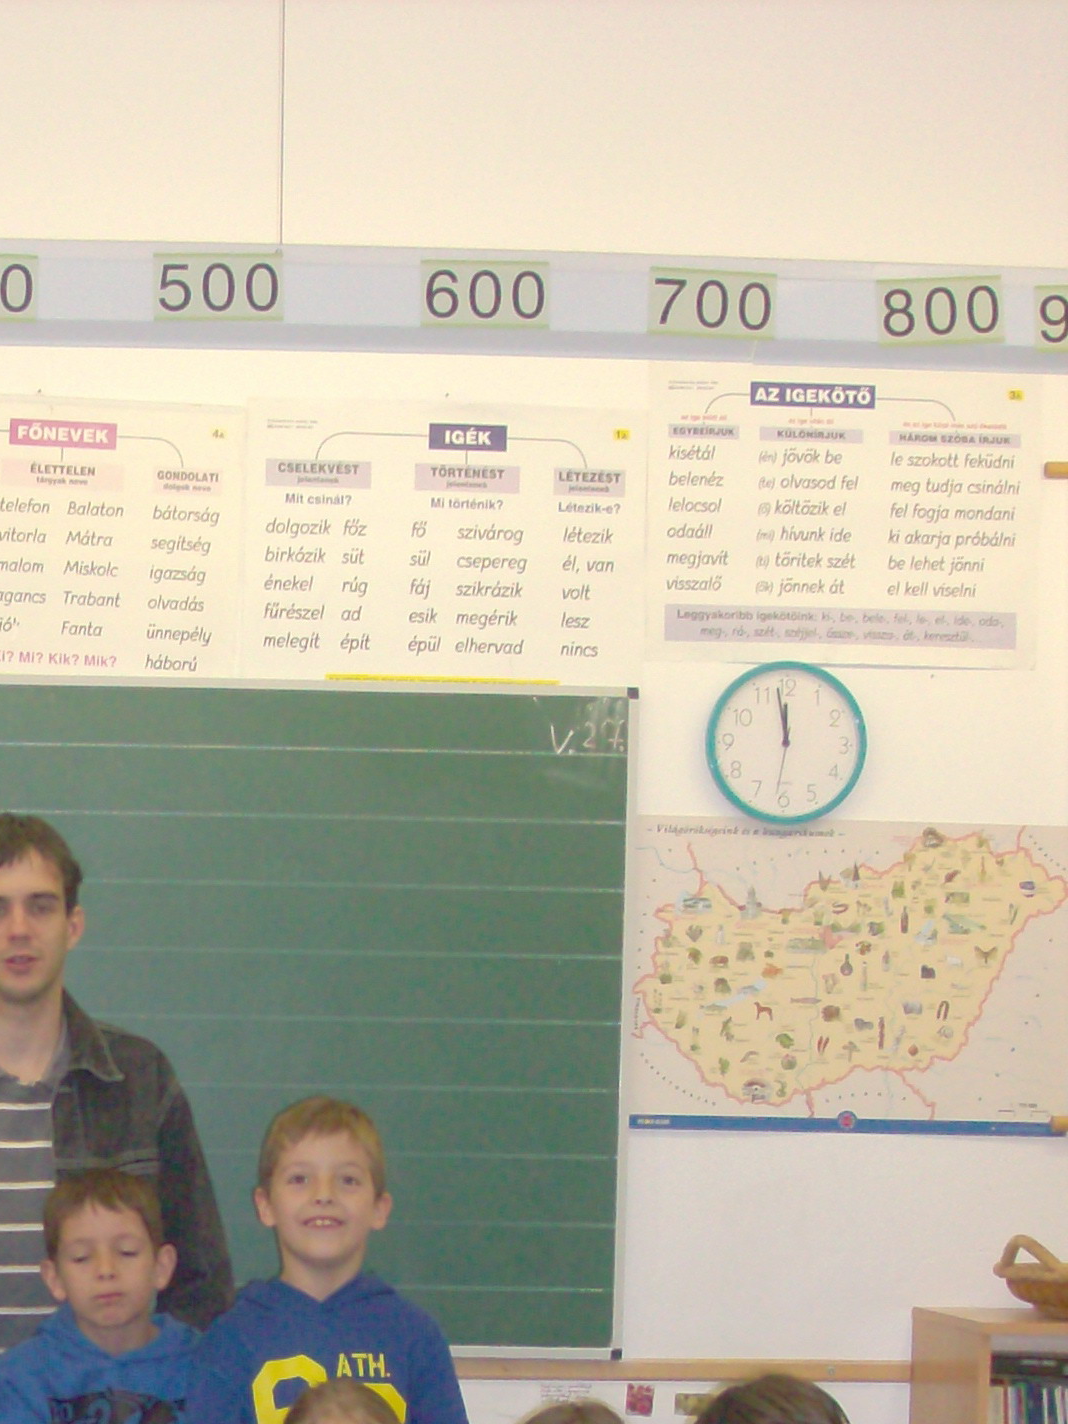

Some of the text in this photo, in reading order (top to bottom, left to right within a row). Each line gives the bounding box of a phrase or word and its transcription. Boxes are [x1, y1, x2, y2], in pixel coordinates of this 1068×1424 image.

[159, 263, 278, 311] 500
[426, 270, 544, 319] 600
[655, 278, 771, 330] 700
[884, 286, 998, 337] 800
[755, 387, 871, 404] AZ IGEKÖTŐ
[18, 423, 108, 443] FŐNEVEK
[445, 427, 491, 445] IGÉK
[669, 445, 715, 460] kisétál
[907, 453, 1015, 468] szokott feküdni
[31, 462, 95, 477] ÉLETTELEN
[157, 470, 218, 482] GONDOLATI
[278, 462, 359, 474] CSELEKVÉST
[431, 465, 505, 479] TÖRTÉNÉST
[559, 470, 621, 483] LÉTEZÉST
[669, 471, 724, 486] belenéz
[780, 474, 836, 489] olvasod
[891, 478, 1020, 497] meg tudja csinálni
[0, 497, 123, 517] telefon Balaton
[285, 493, 352, 505] Mit csinál?
[449, 499, 503, 509] történik?
[669, 497, 722, 513] lelocsol
[153, 505, 220, 527] bátorság
[559, 502, 620, 514] Létezik-e?
[912, 503, 1015, 523] fogja mondani
[0, 527, 113, 546] vitorla Mátra
[266, 518, 367, 538] dolgozik főz
[458, 524, 524, 545] szivárog
[563, 527, 613, 543] létezik
[667, 523, 713, 539] odaáll
[780, 526, 825, 541] hívunk
[151, 536, 211, 556] segítség
[905, 530, 1015, 549] akarja próbálni
[265, 546, 364, 564] birkózik süt
[410, 550, 527, 574] sül csepereg
[667, 550, 728, 569] megjavít
[910, 556, 945, 571] lehet
[64, 560, 118, 577] Miskolc
[587, 561, 614, 572] van
[150, 565, 206, 586] igazság
[264, 574, 368, 597] énekel rúg
[410, 578, 522, 600] fáj szikrázik
[563, 585, 590, 600] volt
[64, 591, 120, 607] Trabant
[148, 595, 204, 612] olvadás
[264, 603, 324, 620] fűrészel
[409, 608, 517, 630] esik megérik
[61, 621, 102, 636] Fanta
[561, 612, 590, 629] lesz
[147, 624, 212, 647] ünnepély
[263, 632, 370, 653] melegít épít
[408, 636, 524, 656] épül elhervad
[561, 641, 598, 657] nincs
[19, 651, 43, 663] Mi?
[49, 653, 79, 665] Kik?
[84, 655, 116, 667] Mik?
[145, 654, 197, 671] háború
[779, 679, 796, 697] 12
[733, 709, 752, 727] 10
[829, 709, 841, 727] 2
[723, 733, 735, 751] 9
[839, 737, 849, 754] 3
[729, 761, 742, 778] 8
[828, 763, 840, 780] 4
[752, 780, 762, 798] 7
[807, 784, 817, 802] 5
[336, 1353, 390, 1378] ATH.
